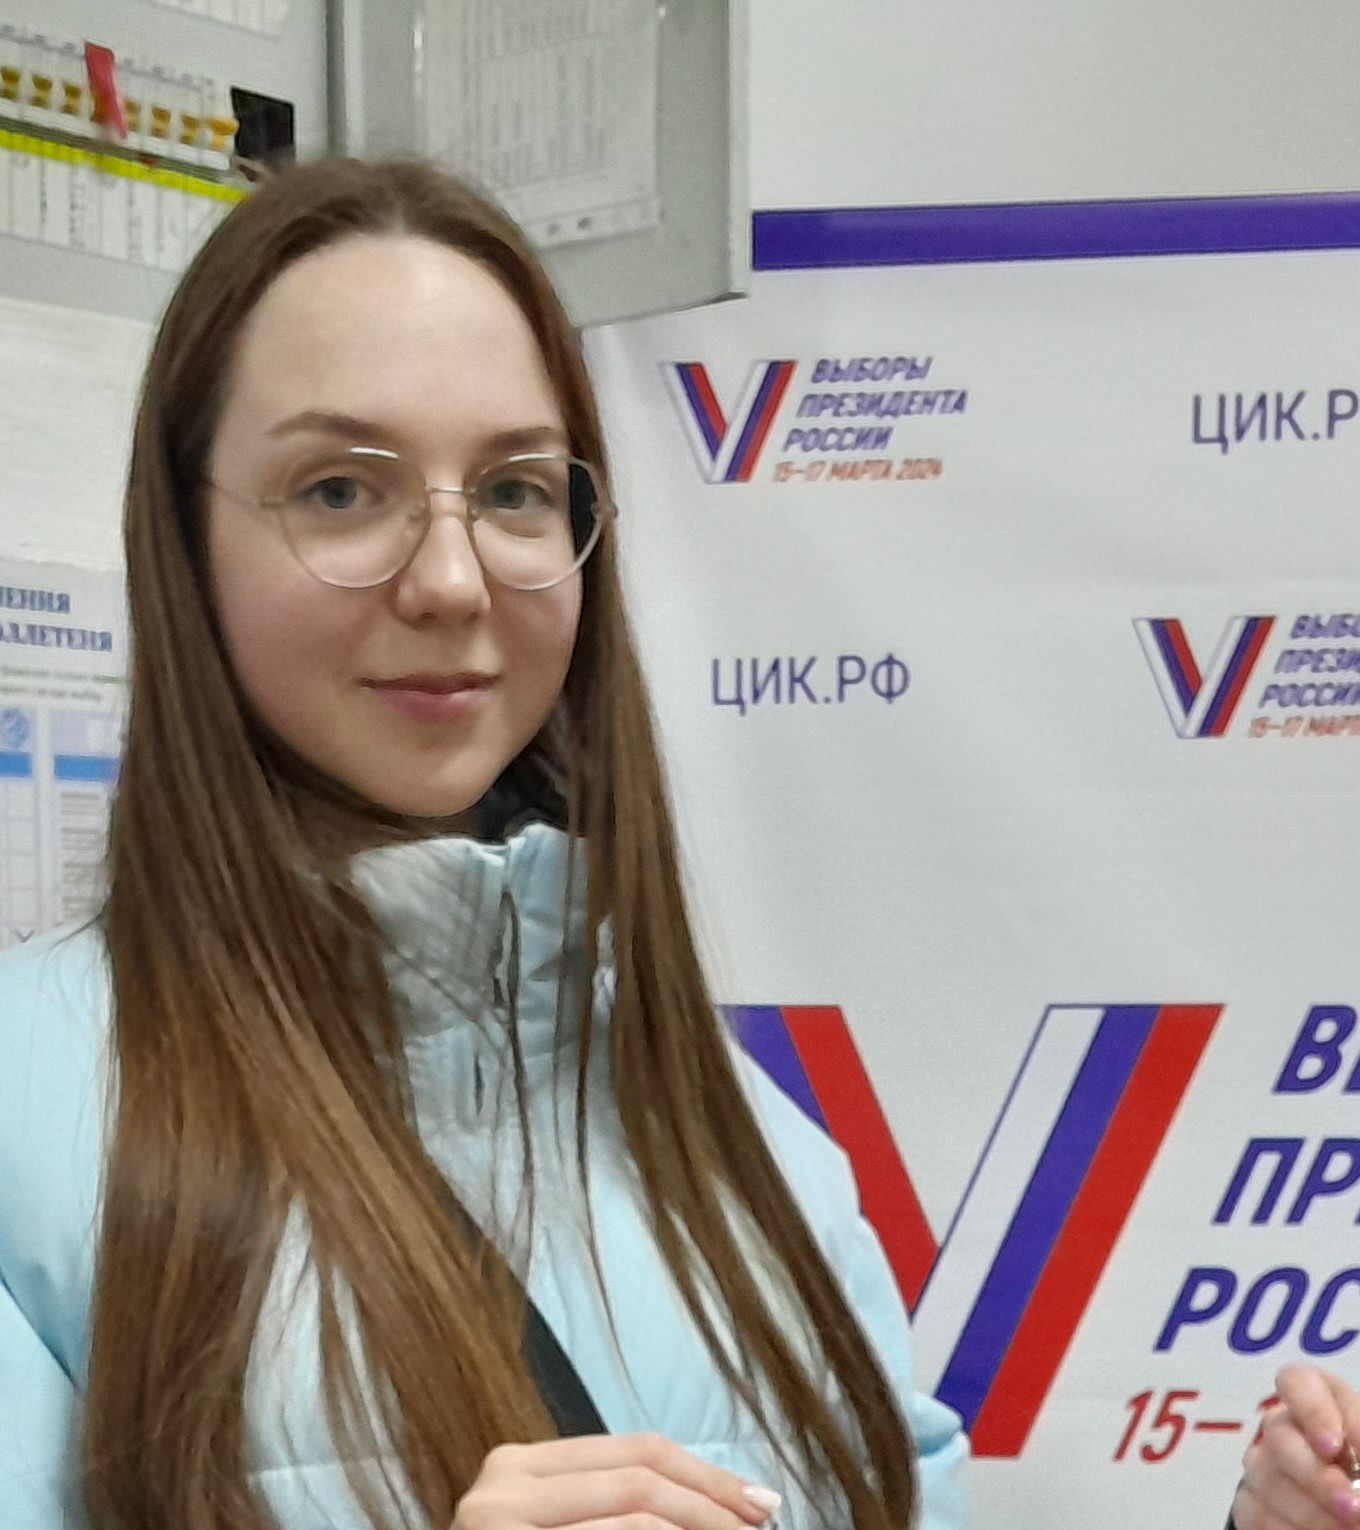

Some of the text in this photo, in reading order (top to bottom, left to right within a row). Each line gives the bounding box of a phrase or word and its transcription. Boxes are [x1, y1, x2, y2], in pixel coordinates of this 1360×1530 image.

[812, 356, 932, 383] ВЫБОРЫ
[796, 389, 968, 418] ПРЕЗИДЕНТА
[783, 426, 892, 453] РОССИИ
[712, 653, 910, 716] ЦИК.РФ
